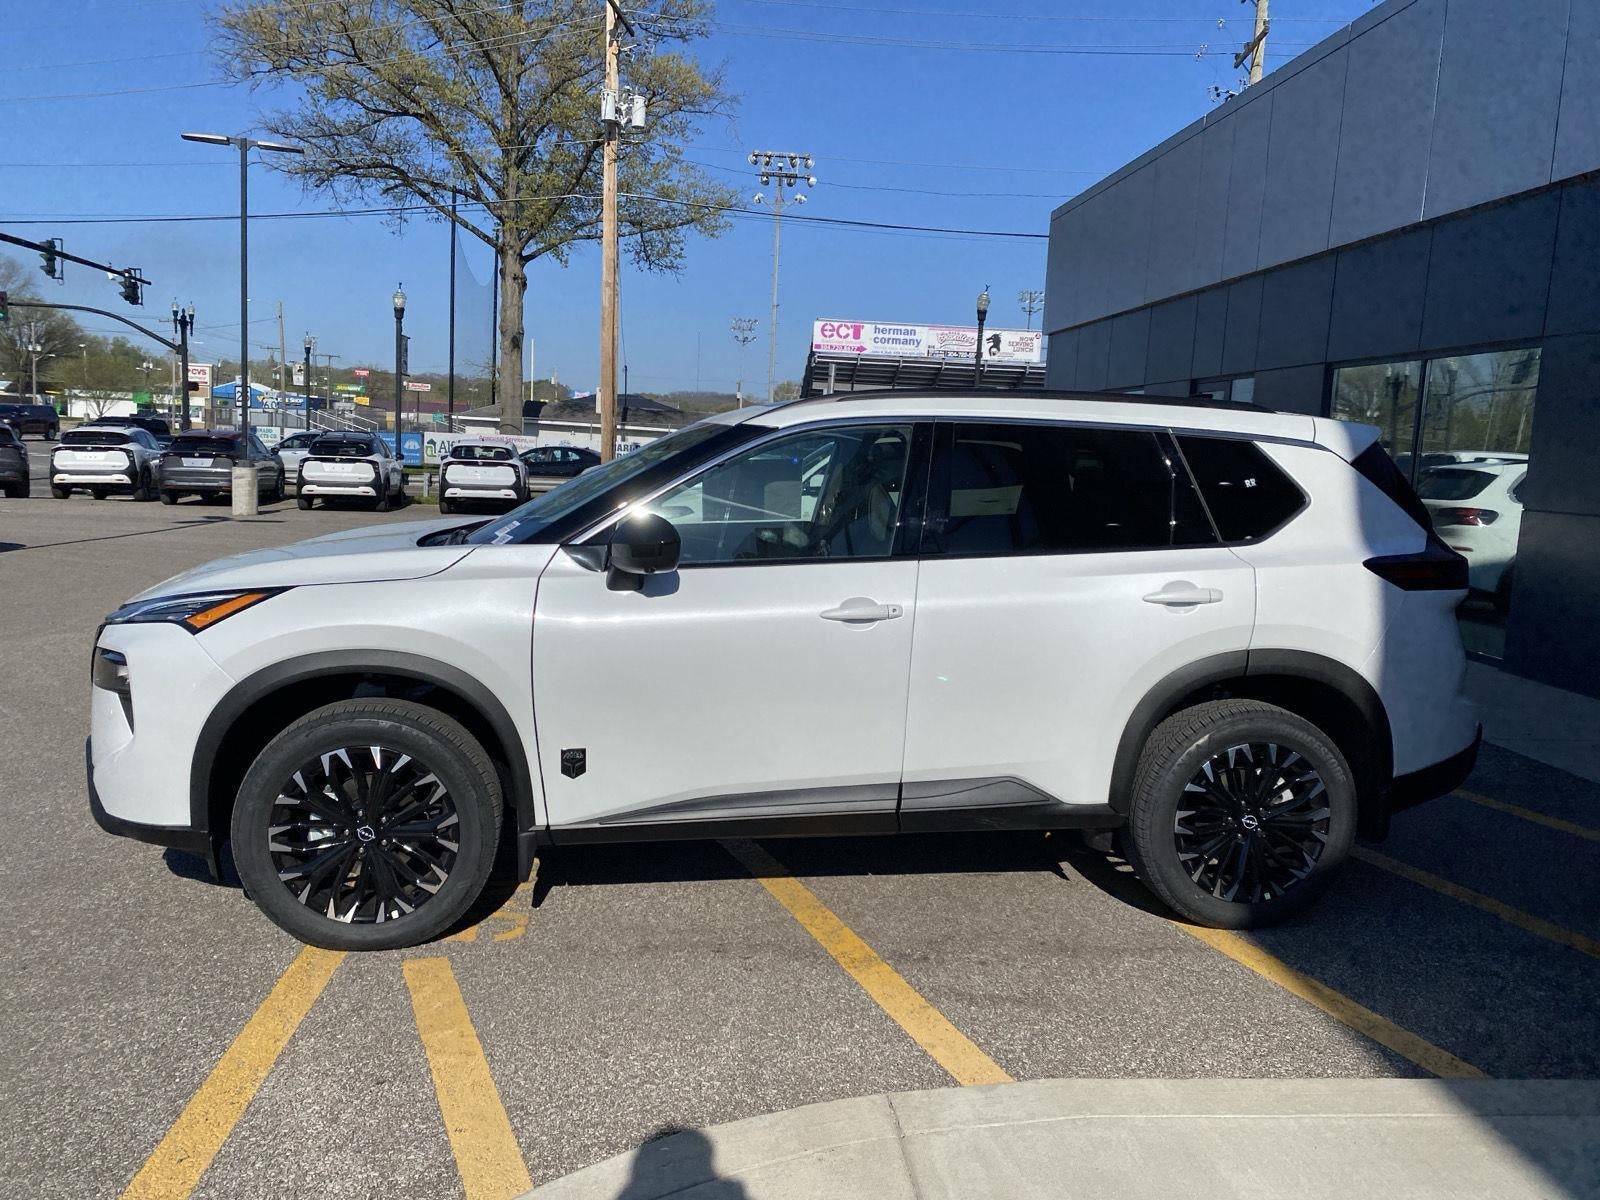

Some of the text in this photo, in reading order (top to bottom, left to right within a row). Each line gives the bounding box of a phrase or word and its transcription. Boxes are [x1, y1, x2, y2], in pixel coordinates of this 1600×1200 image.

[874, 325, 917, 337] herman
[873, 335, 922, 348] cormany
[191, 368, 207, 376] CVS
[264, 400, 277, 409] 60
